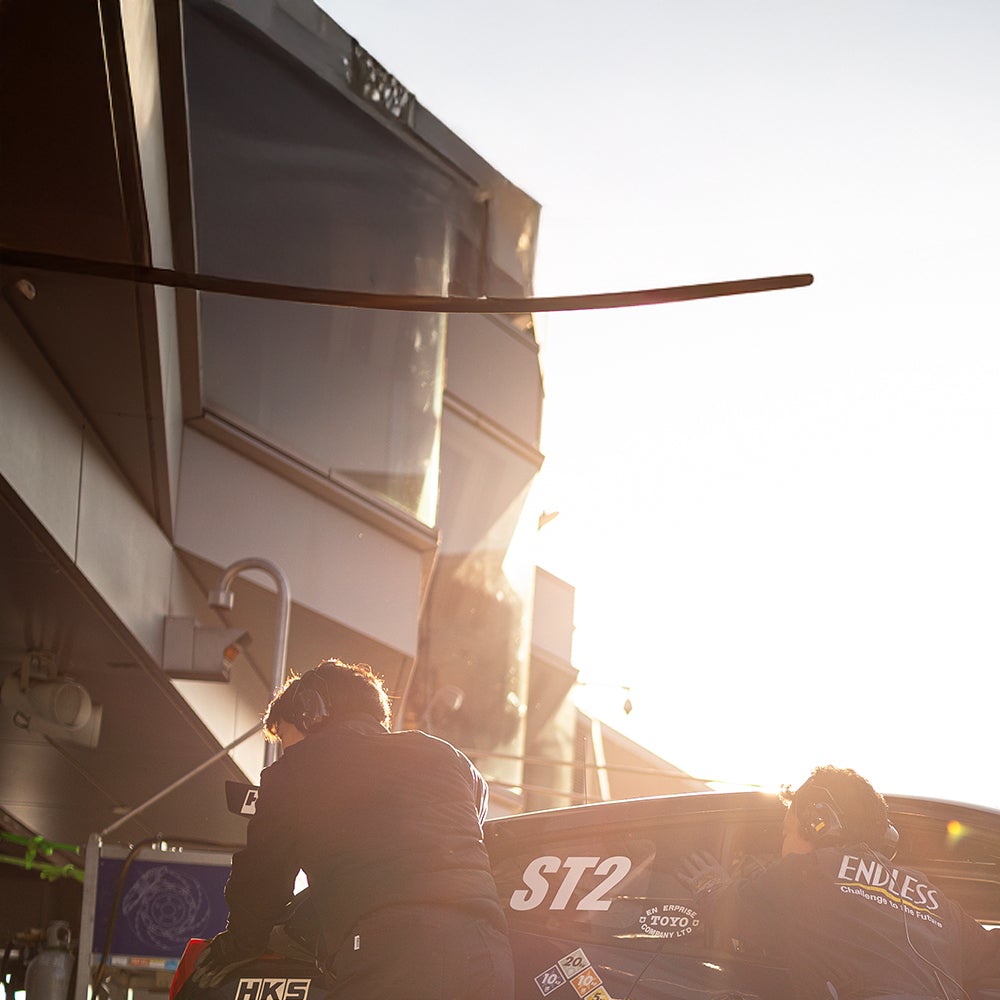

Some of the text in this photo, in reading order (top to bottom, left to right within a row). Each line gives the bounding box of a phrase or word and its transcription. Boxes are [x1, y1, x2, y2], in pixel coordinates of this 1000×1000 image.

[510, 856, 632, 911] ST2
[838, 855, 940, 910] ENDLESS
[650, 915, 689, 928] TOYO
[840, 886, 888, 905] Challenge
[889, 900, 898, 910] to
[916, 911, 943, 928] Future
[641, 923, 692, 939] COMPANY LTD
